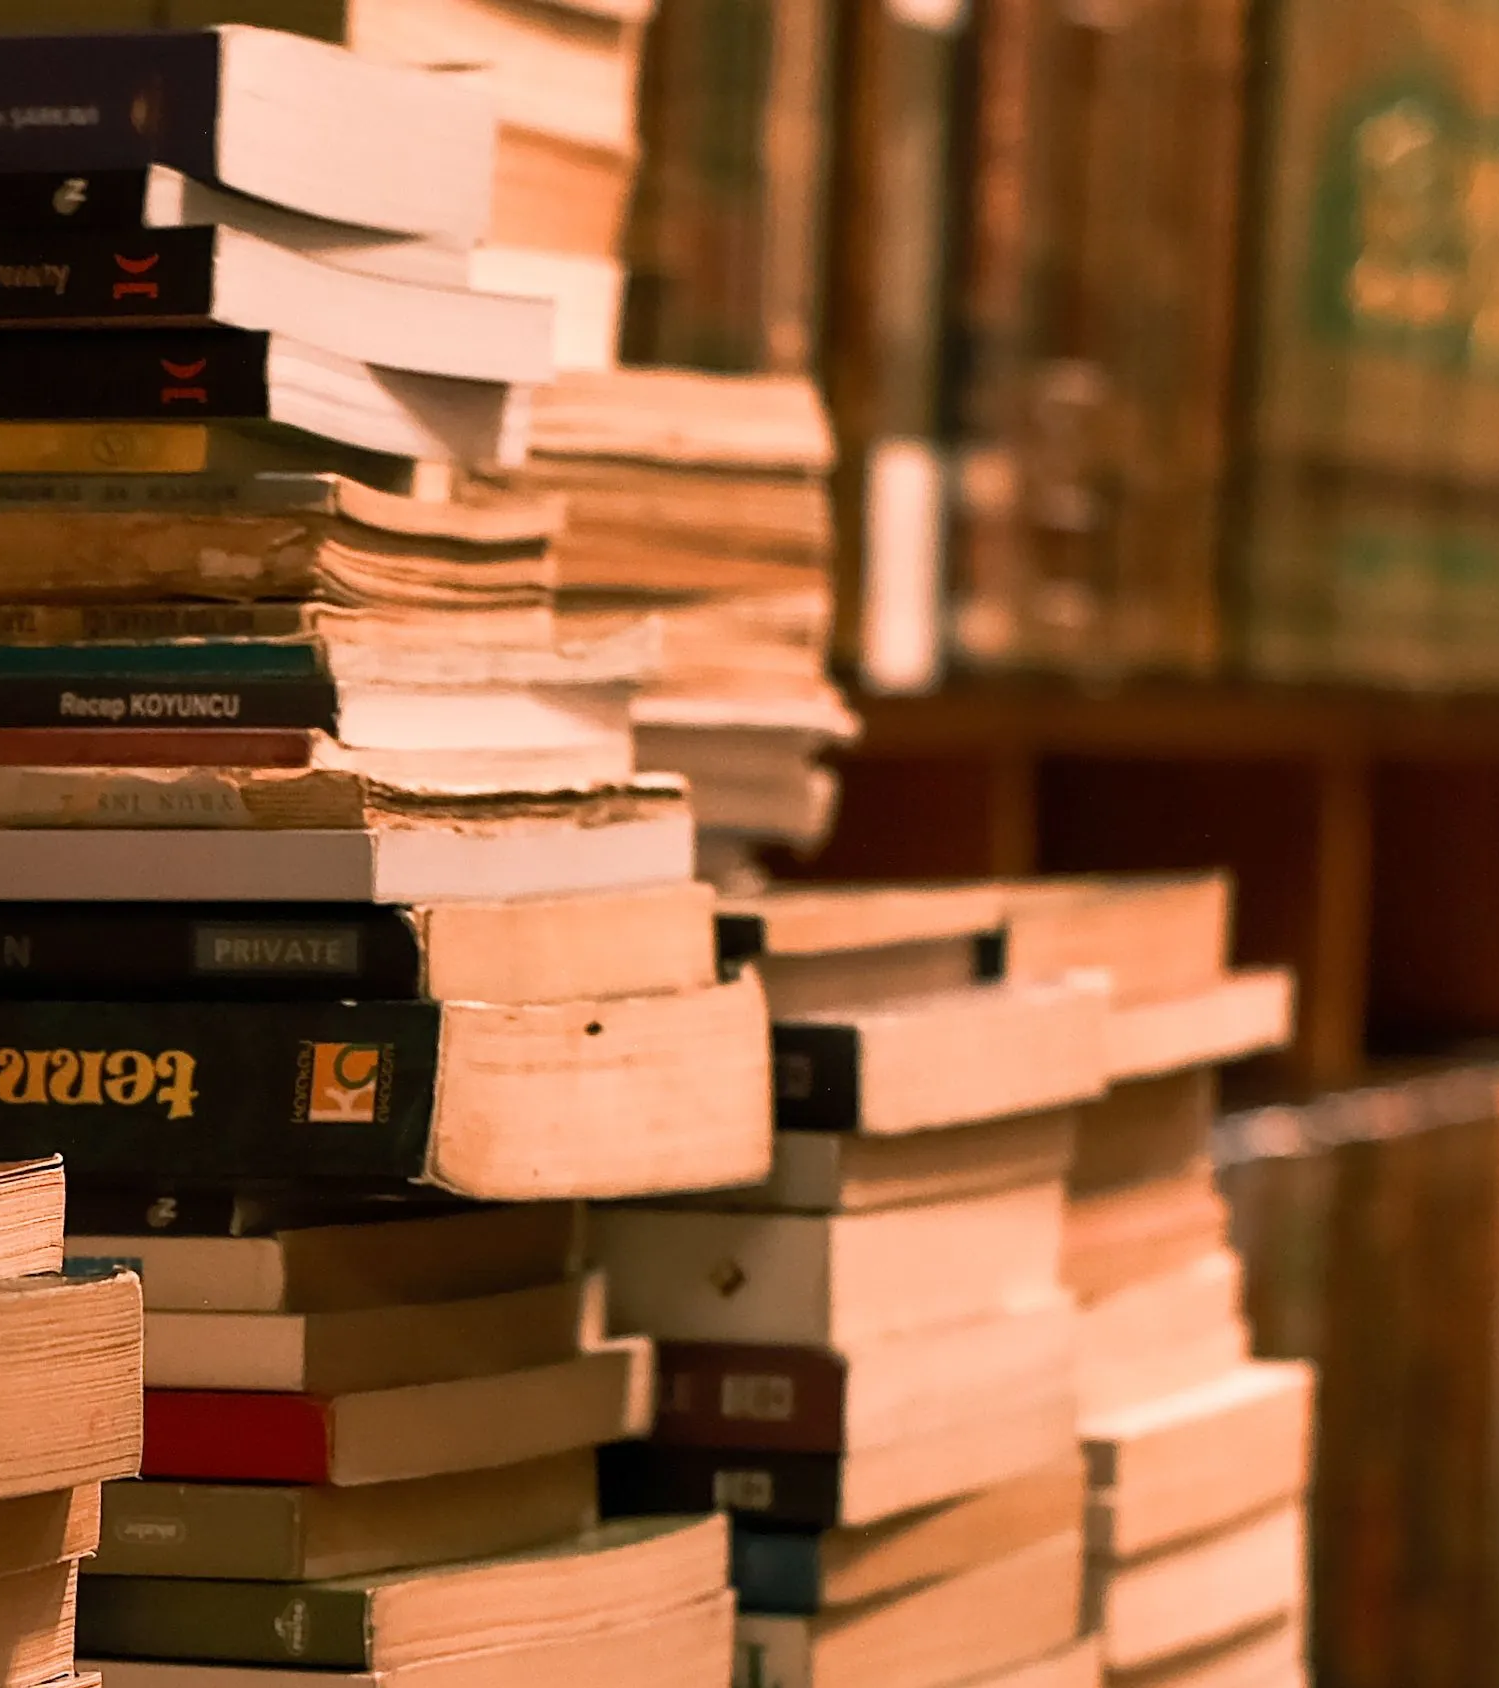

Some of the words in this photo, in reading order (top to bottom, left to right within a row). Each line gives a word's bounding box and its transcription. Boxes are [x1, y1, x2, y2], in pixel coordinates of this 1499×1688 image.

[59, 691, 128, 722] Recep
[129, 692, 241, 718] KOYUNCU
[213, 936, 343, 966] PRIVATE
